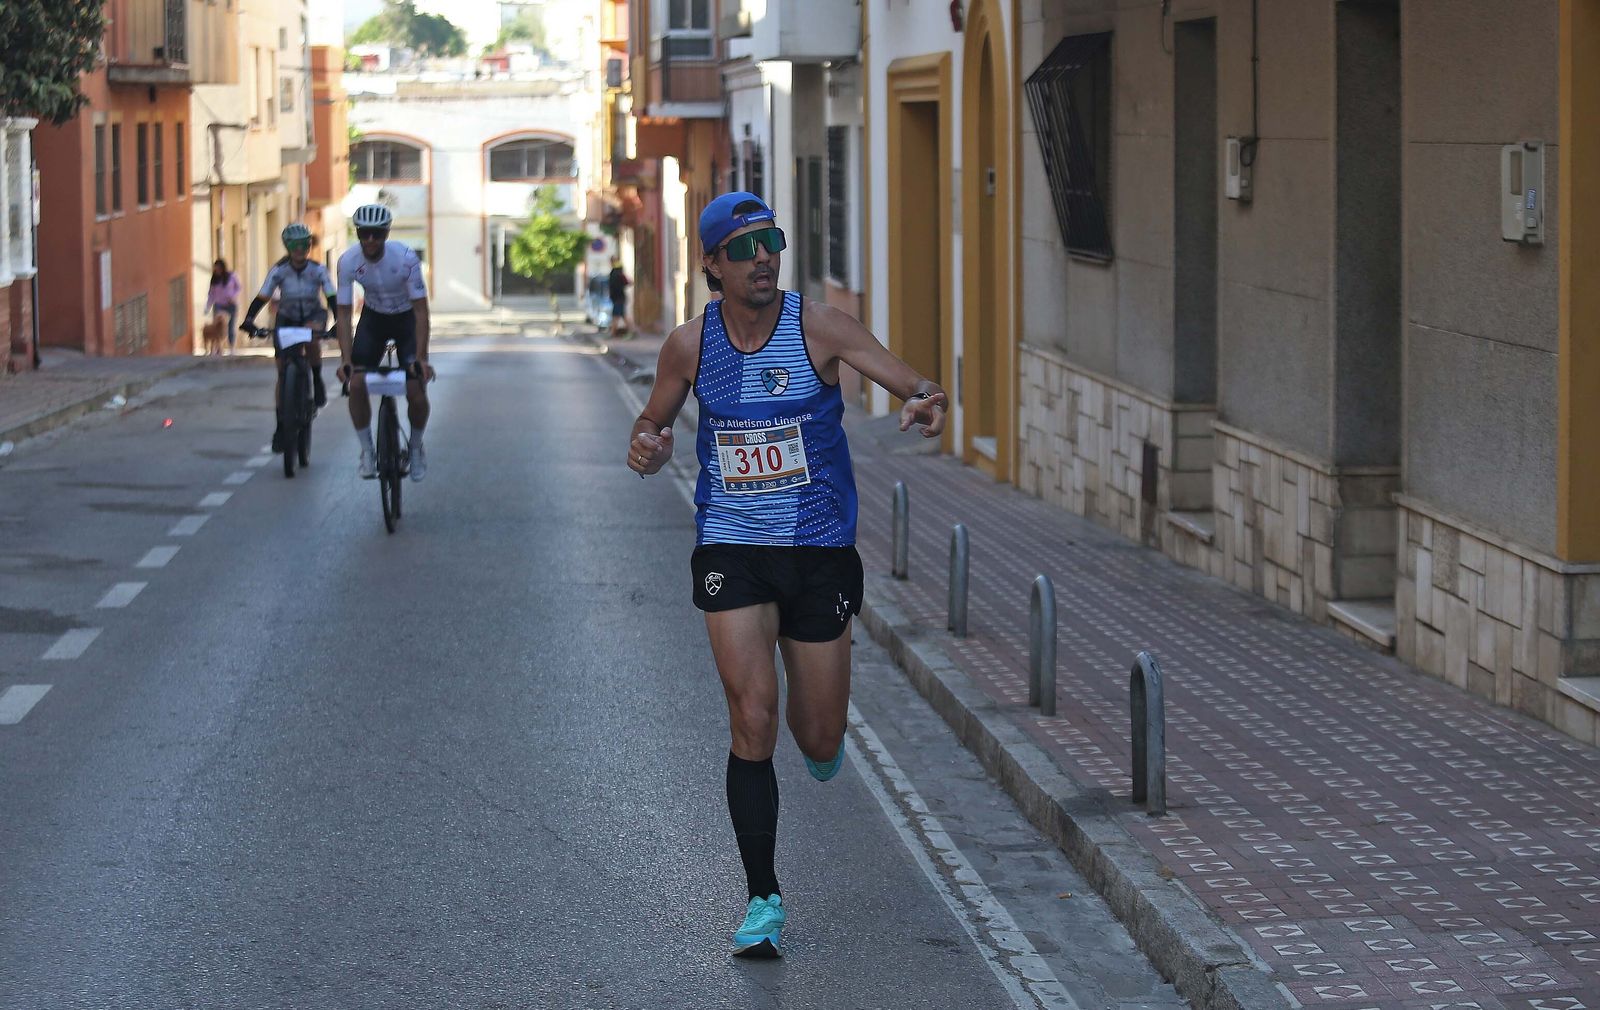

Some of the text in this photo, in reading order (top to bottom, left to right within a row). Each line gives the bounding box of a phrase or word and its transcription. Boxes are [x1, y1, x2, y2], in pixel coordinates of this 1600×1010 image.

[727, 419, 772, 428] Atletismo
[774, 413, 813, 426] Linense
[744, 432, 767, 444] CROSS
[734, 445, 783, 475] 310
